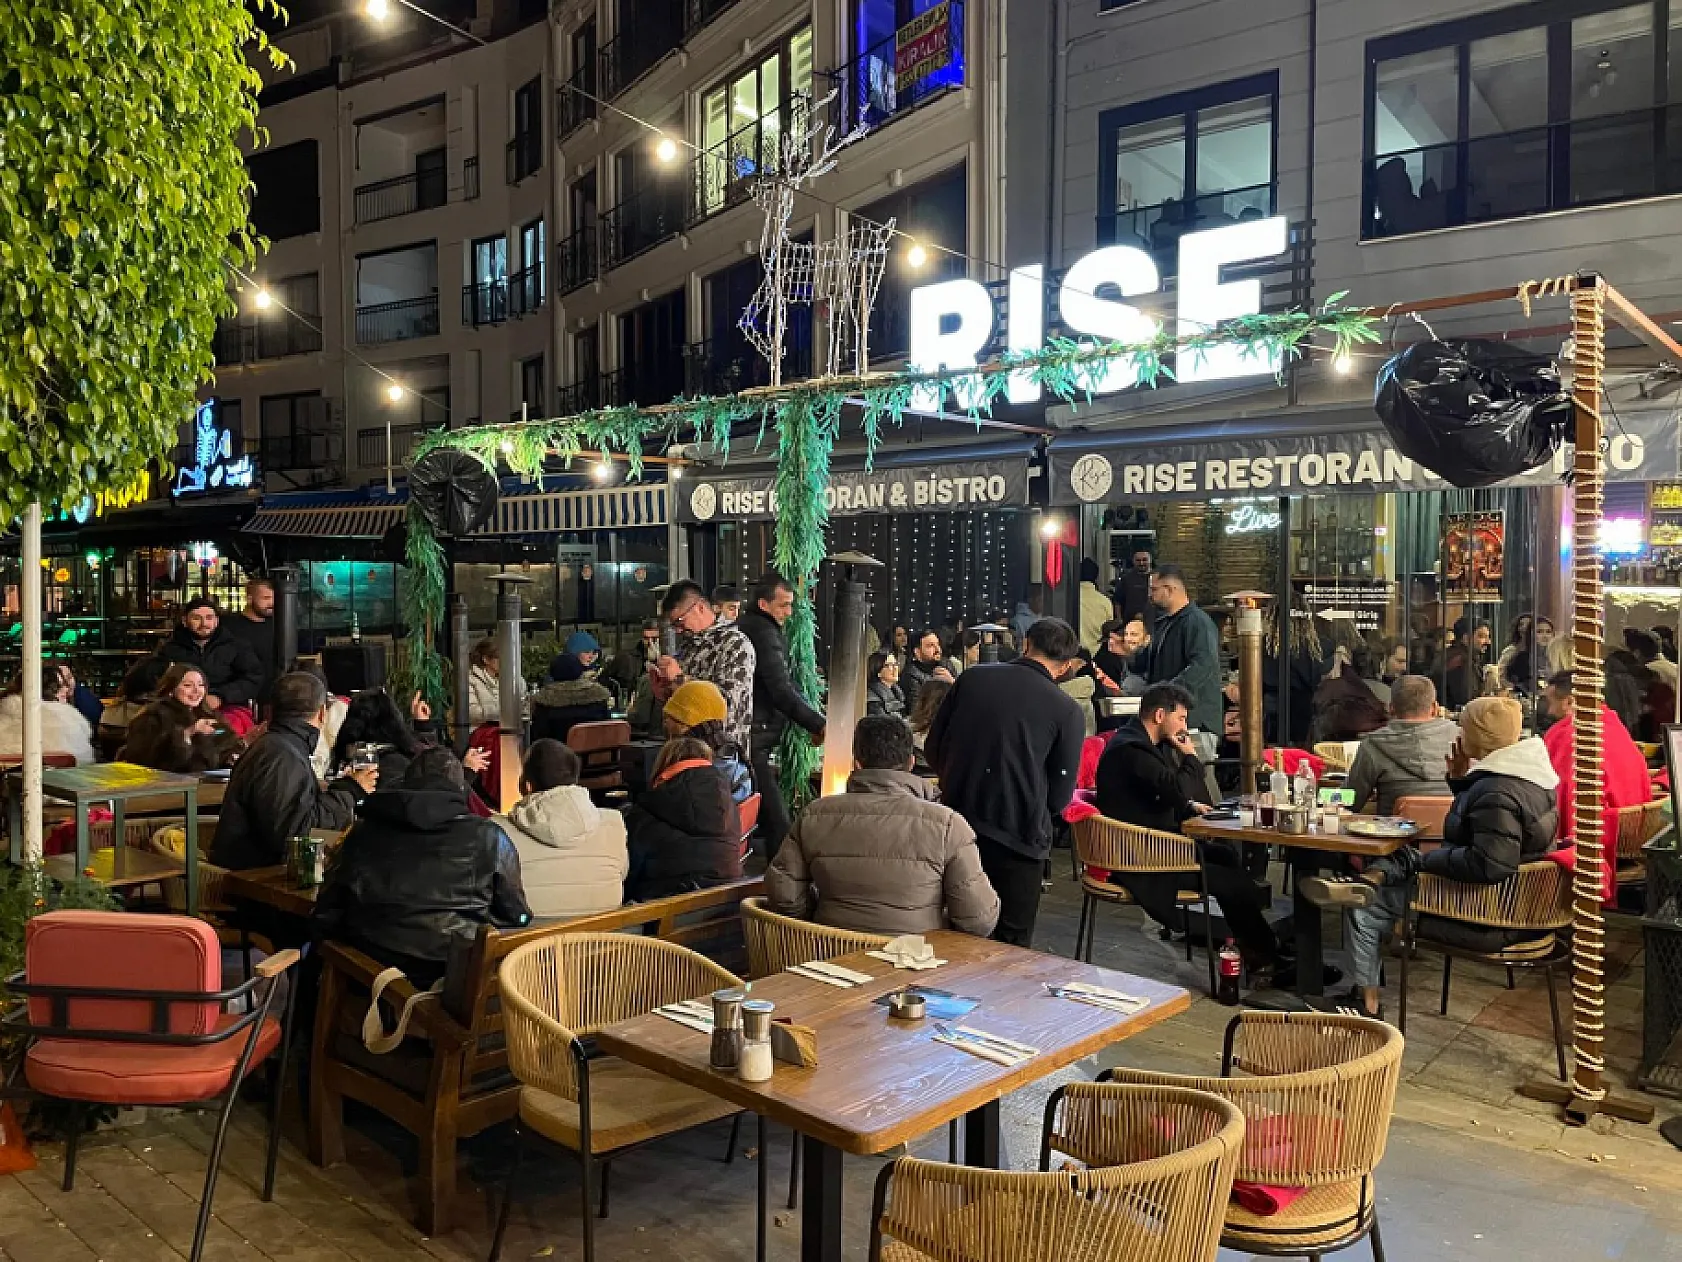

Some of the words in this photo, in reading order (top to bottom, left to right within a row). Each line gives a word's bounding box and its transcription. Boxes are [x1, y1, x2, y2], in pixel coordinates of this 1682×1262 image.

[910, 216, 1287, 412] RISE
[722, 491, 765, 514] RISE
[890, 481, 908, 507] &
[913, 472, 1006, 505] BİSTRO
[1123, 461, 1197, 494] RISE
[1204, 448, 1413, 492] RESTORAN
[1225, 505, 1281, 534] Live
